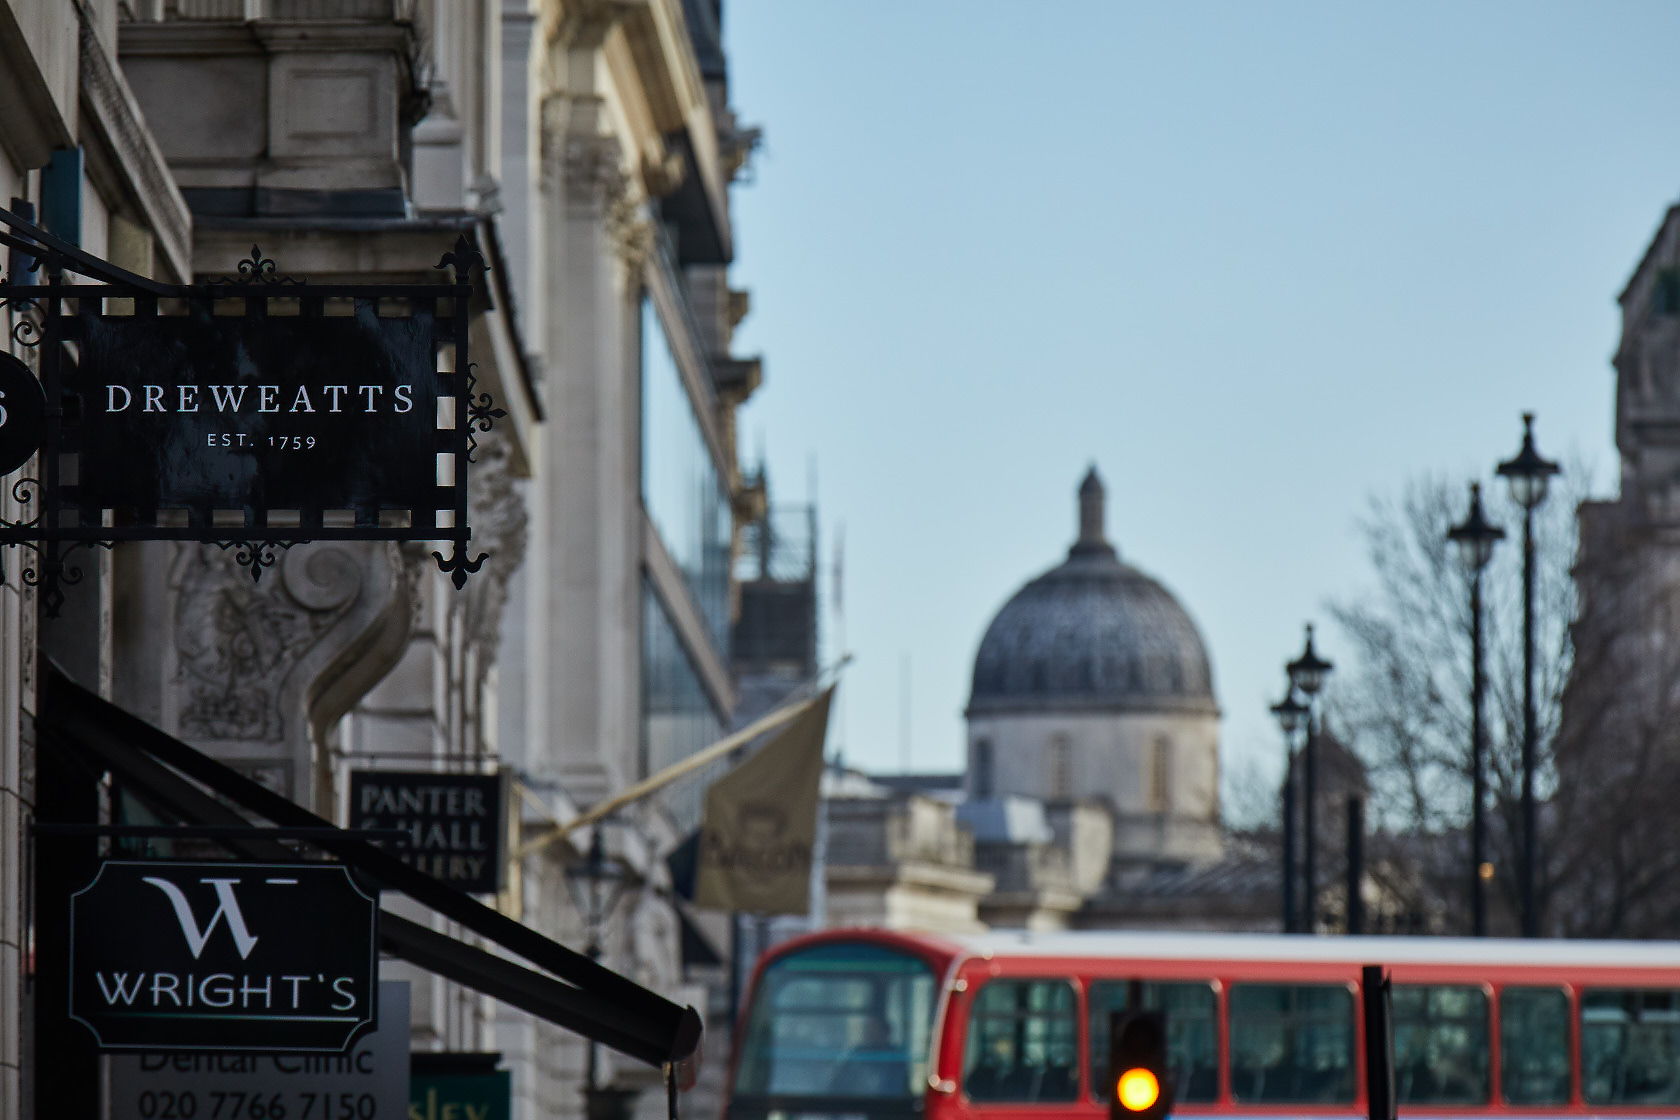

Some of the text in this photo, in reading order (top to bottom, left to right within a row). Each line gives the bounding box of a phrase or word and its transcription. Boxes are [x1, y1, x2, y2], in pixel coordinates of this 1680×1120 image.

[105, 384, 413, 413] DREWEATTS
[207, 433, 317, 450] EST. 1759
[360, 783, 488, 816] PANTER
[96, 971, 357, 1011] WRIGHT'S
[138, 1090, 376, 1120] 020 7766 7150
